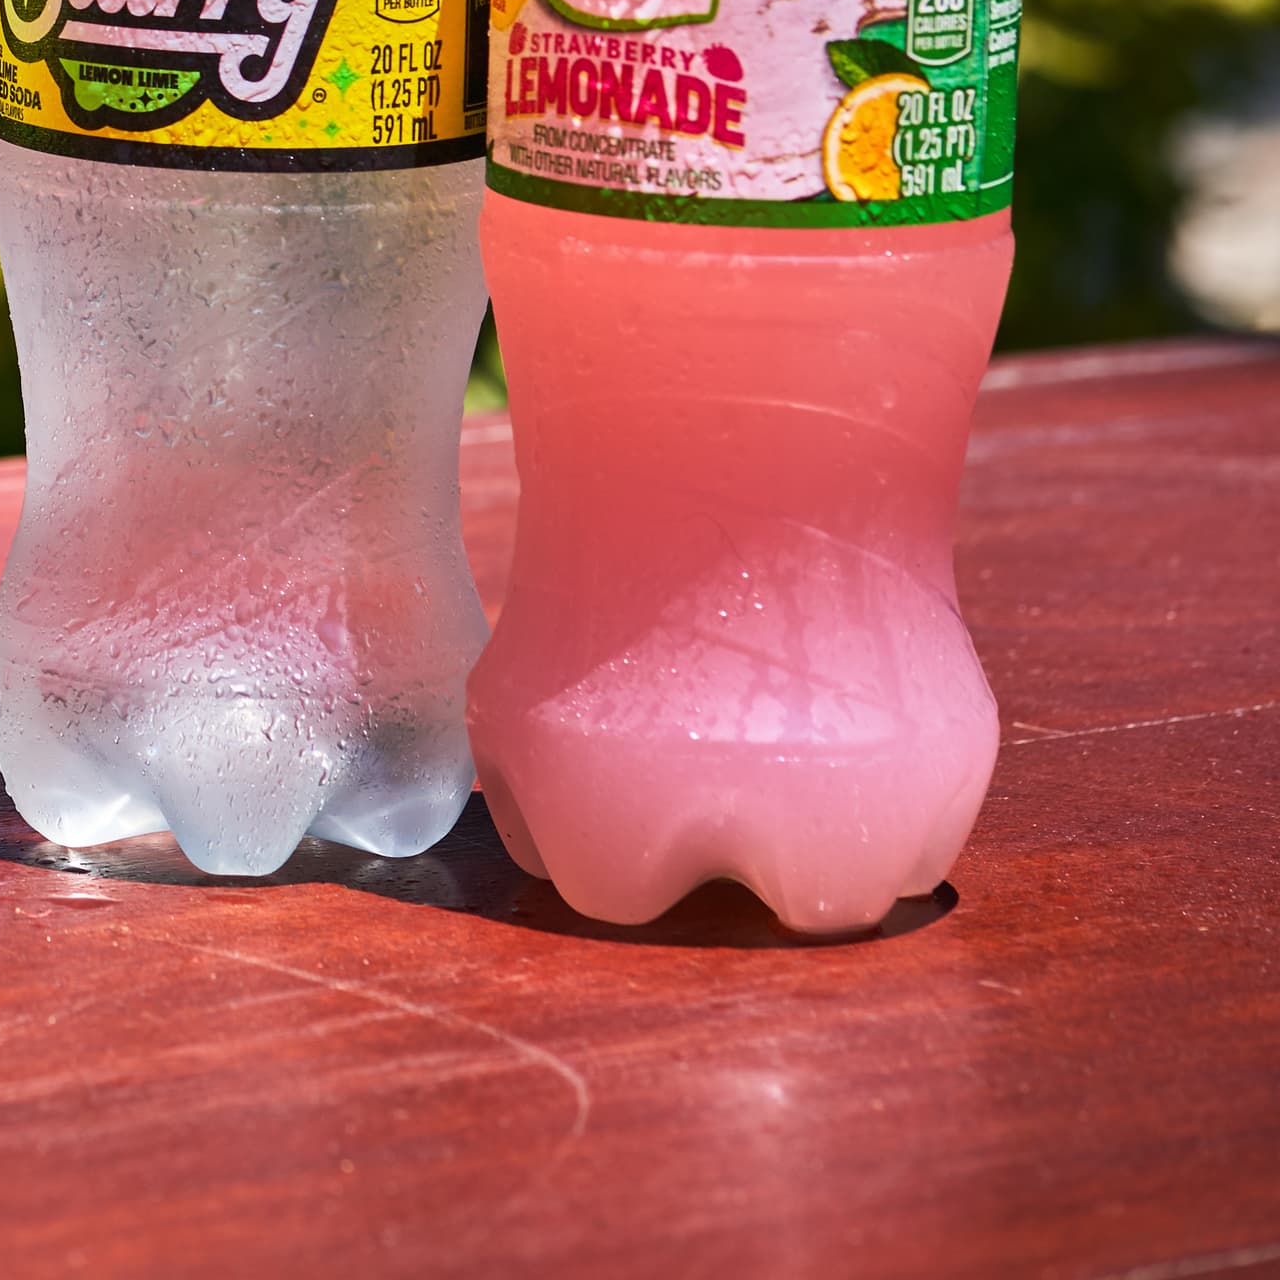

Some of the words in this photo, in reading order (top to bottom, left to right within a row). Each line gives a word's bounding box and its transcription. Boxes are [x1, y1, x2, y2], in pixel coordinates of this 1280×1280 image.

[914, 14, 969, 34] CALORIES
[371, 44, 393, 75] 20
[399, 42, 419, 73] FL
[423, 39, 443, 70] OZ
[529, 31, 696, 72] STRAWBERRY
[0, 58, 18, 84] LIME
[78, 63, 134, 87] LEMON
[137, 68, 179, 89] LIME
[9, 83, 42, 111] SODA
[370, 77, 411, 112] (1.25
[418, 74, 441, 109] PT)
[504, 56, 747, 150] LEMONADE
[897, 93, 924, 127] 20
[927, 91, 949, 124] FL
[951, 88, 976, 122] OZ
[372, 114, 404, 145] 591
[412, 110, 438, 140] mL
[533, 124, 567, 148] FROM
[569, 130, 676, 162] CONCENTRATE
[893, 127, 943, 167] (1.25
[945, 122, 976, 161] PT)
[509, 143, 533, 167] WITH
[534, 150, 573, 176] OTHER
[575, 158, 641, 185] NATURAL
[646, 165, 723, 191] FLAVORS
[901, 162, 935, 197] 591
